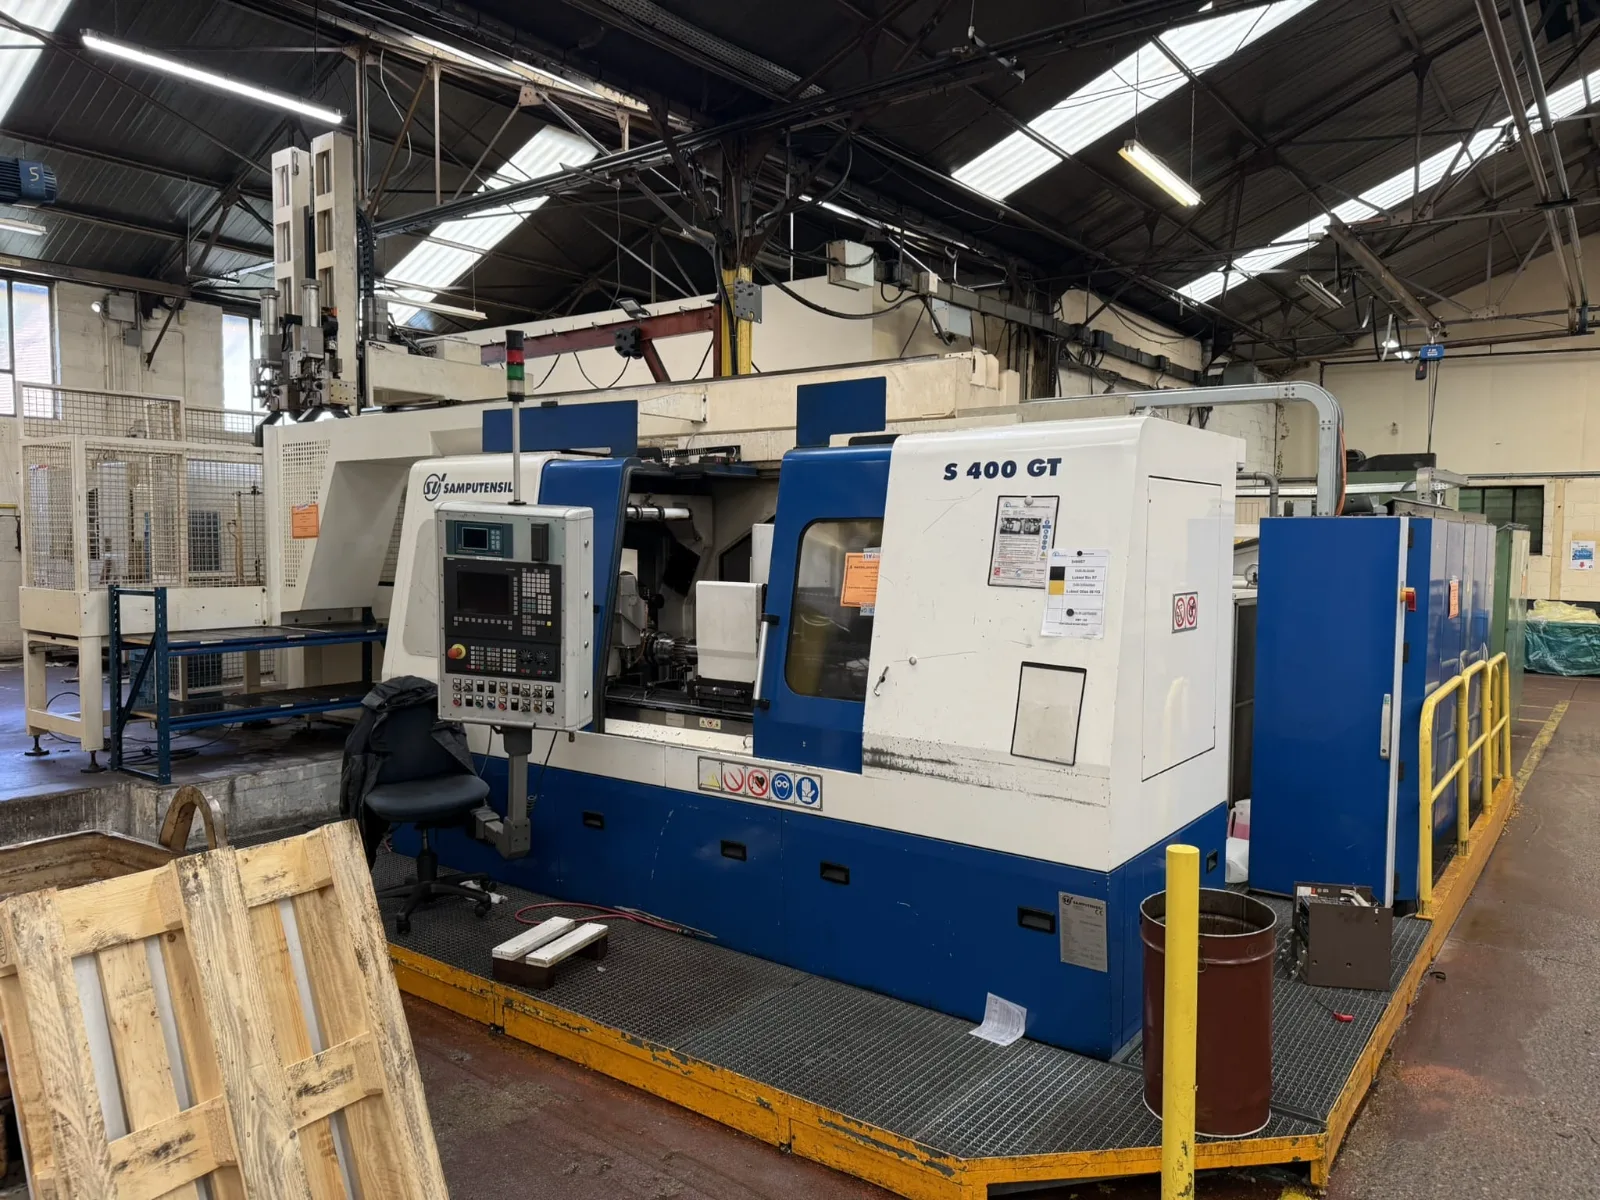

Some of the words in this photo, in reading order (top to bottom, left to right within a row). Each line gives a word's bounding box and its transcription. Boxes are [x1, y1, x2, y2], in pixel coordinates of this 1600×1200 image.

[943, 462, 958, 481] S
[966, 460, 1017, 480] 400
[1027, 457, 1062, 477] GT
[443, 481, 513, 494] SAMPUTENSIL
